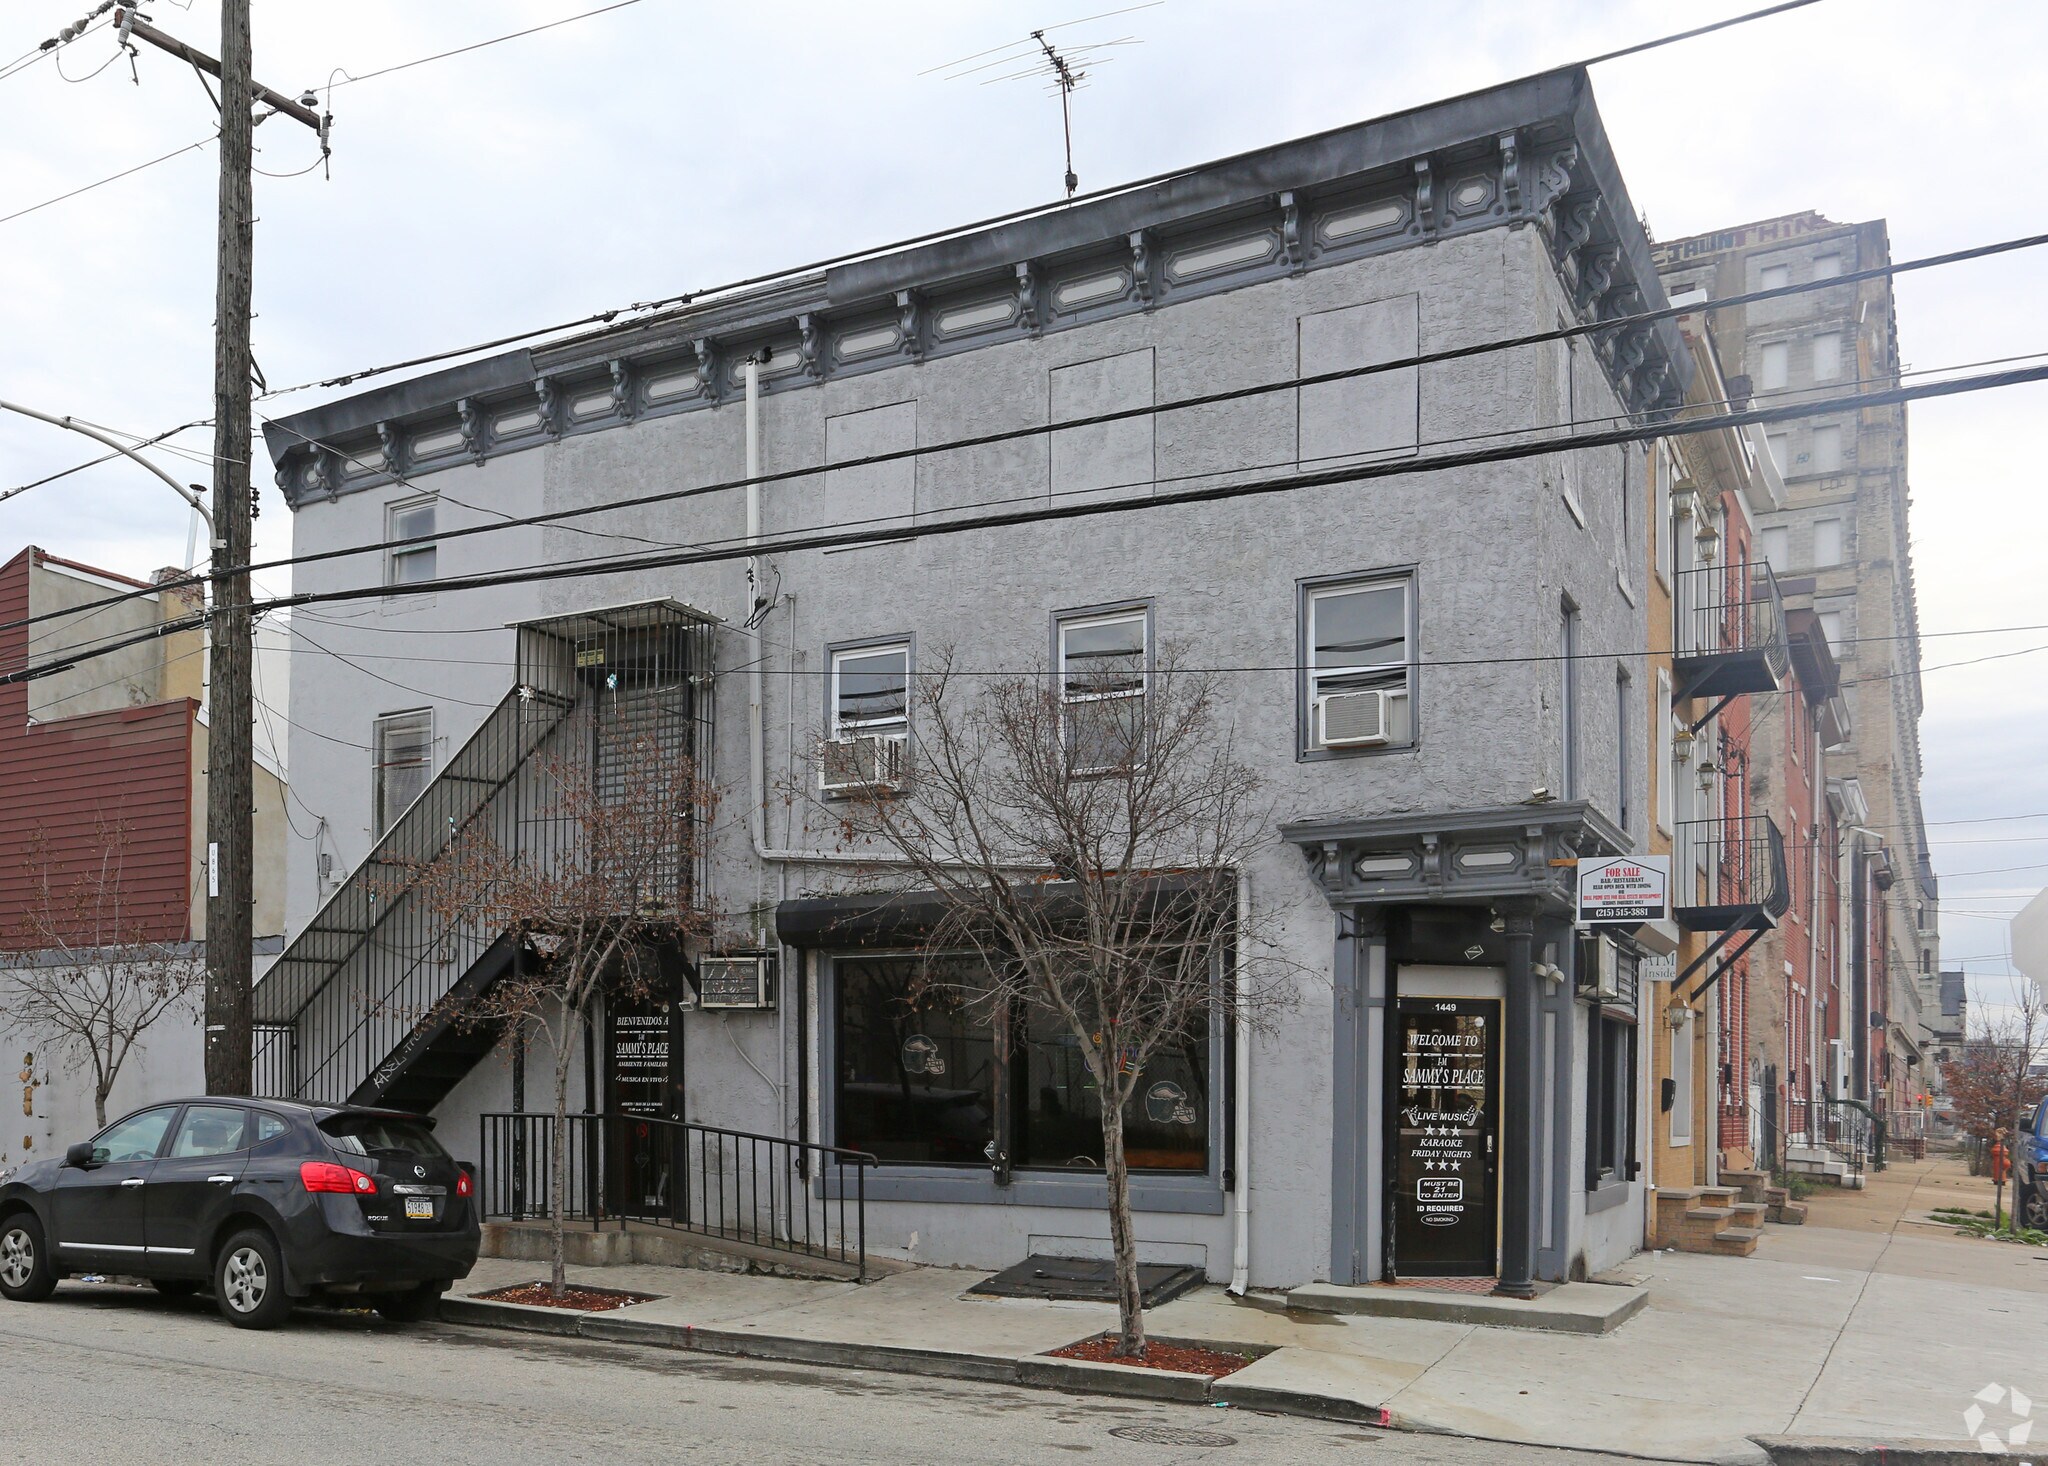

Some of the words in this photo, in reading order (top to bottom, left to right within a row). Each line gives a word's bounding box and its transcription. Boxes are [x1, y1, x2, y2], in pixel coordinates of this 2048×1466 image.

[1605, 868, 1620, 877] FOR
[1623, 867, 1640, 877] SALE
[1596, 909, 1614, 917] (215)
[1615, 908, 1648, 916] 515-3881
[1645, 968, 1675, 978] Inside
[1435, 1003, 1456, 1012] 1449
[616, 1016, 662, 1026] BIENVENIDOS
[663, 1016, 669, 1025] A
[1410, 1034, 1462, 1046] WELCOME
[1464, 1035, 1478, 1046] TO
[616, 1041, 646, 1054] SAMMY'S
[647, 1042, 669, 1054] PLACE
[1403, 1067, 1449, 1084] SAMMY'S
[1451, 1069, 1484, 1084] PLACE
[1417, 1112, 1438, 1120] LIVE
[1440, 1113, 1469, 1121] MUSIC
[1420, 1139, 1463, 1147] KARAOKE
[1411, 1150, 1441, 1158] FRIDAY
